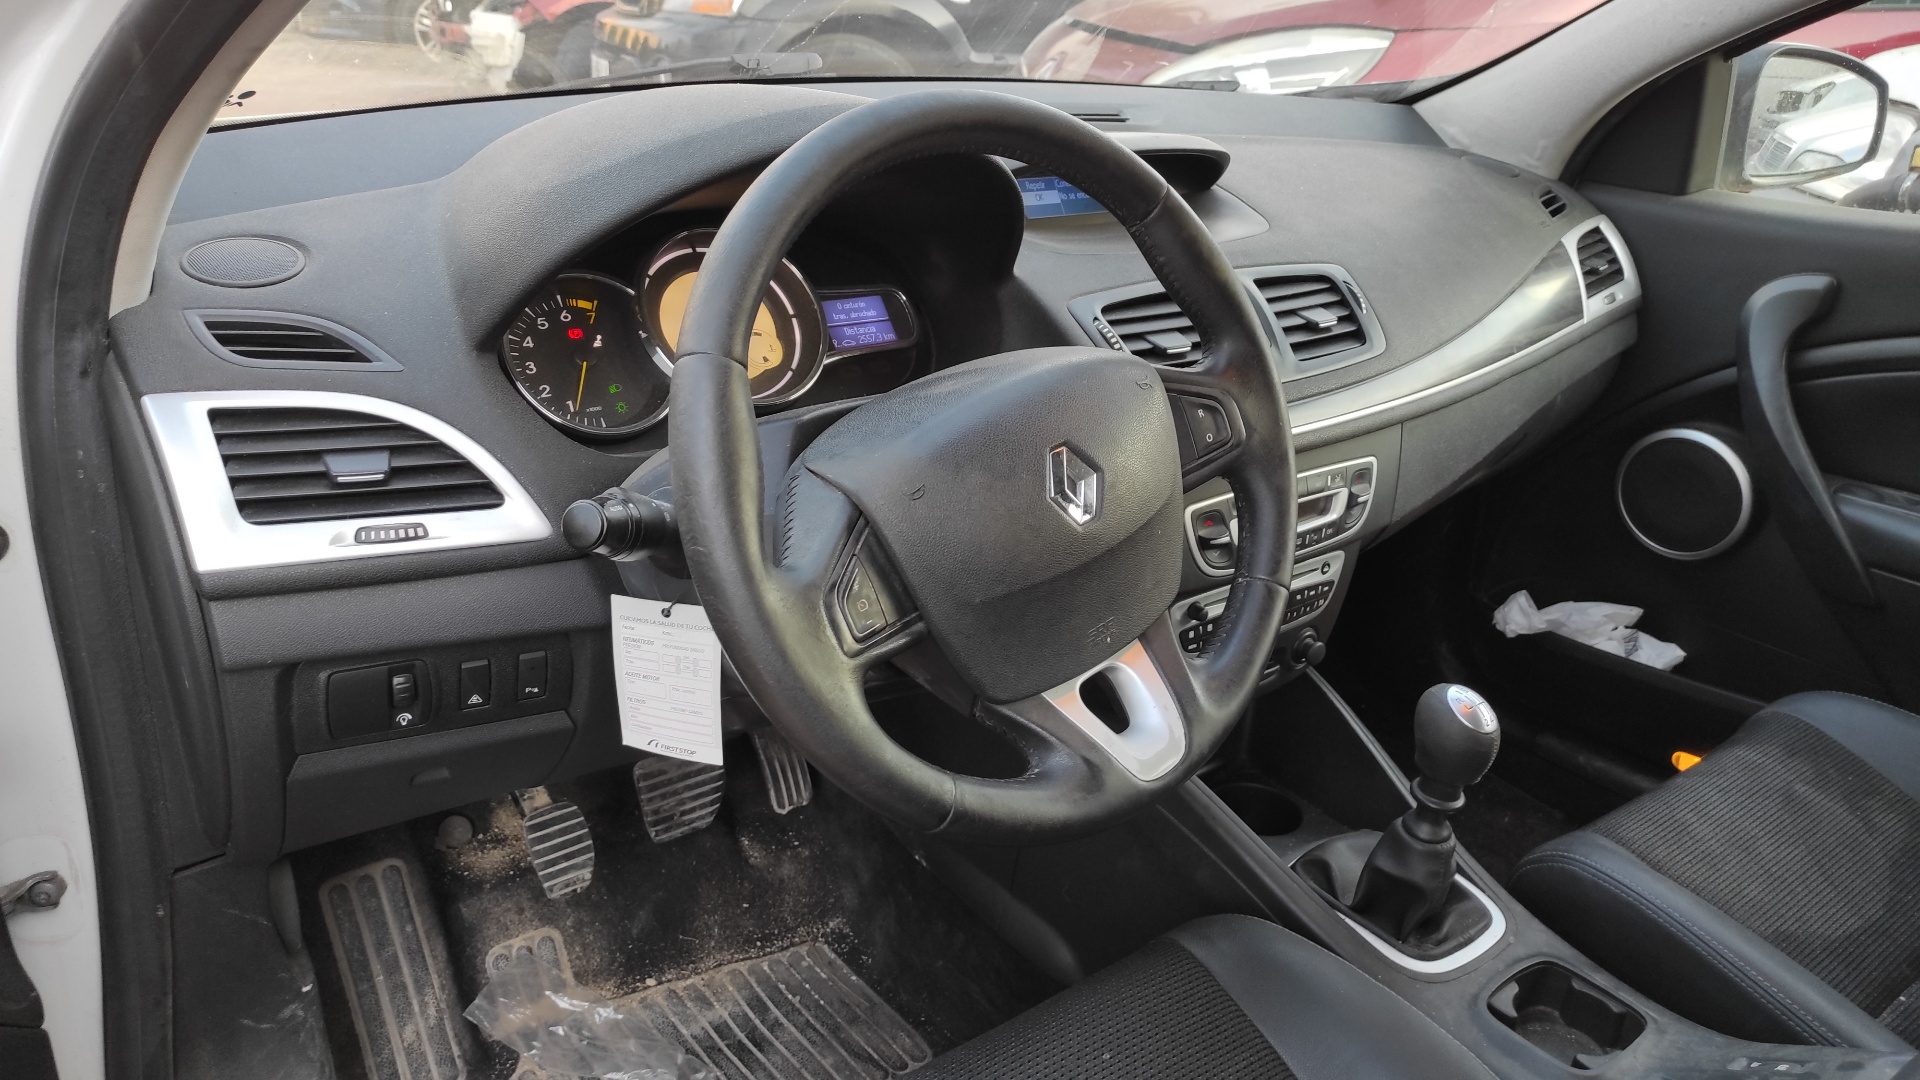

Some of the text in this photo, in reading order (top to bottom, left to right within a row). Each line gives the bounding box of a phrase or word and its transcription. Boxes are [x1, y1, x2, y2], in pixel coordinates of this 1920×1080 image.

[1025, 181, 1045, 191] Repetir
[560, 310, 572, 322] 6
[586, 312, 596, 324] 7
[537, 318, 549, 330] 5
[844, 326, 876, 335] Distancia
[523, 336, 534, 348] 4
[525, 362, 537, 374] 3
[539, 385, 551, 398] 2
[566, 400, 574, 412] 1
[1197, 409, 1205, 418] R
[625, 670, 660, 681] ACEITE MOTOR
[627, 696, 646, 705] FILTROS
